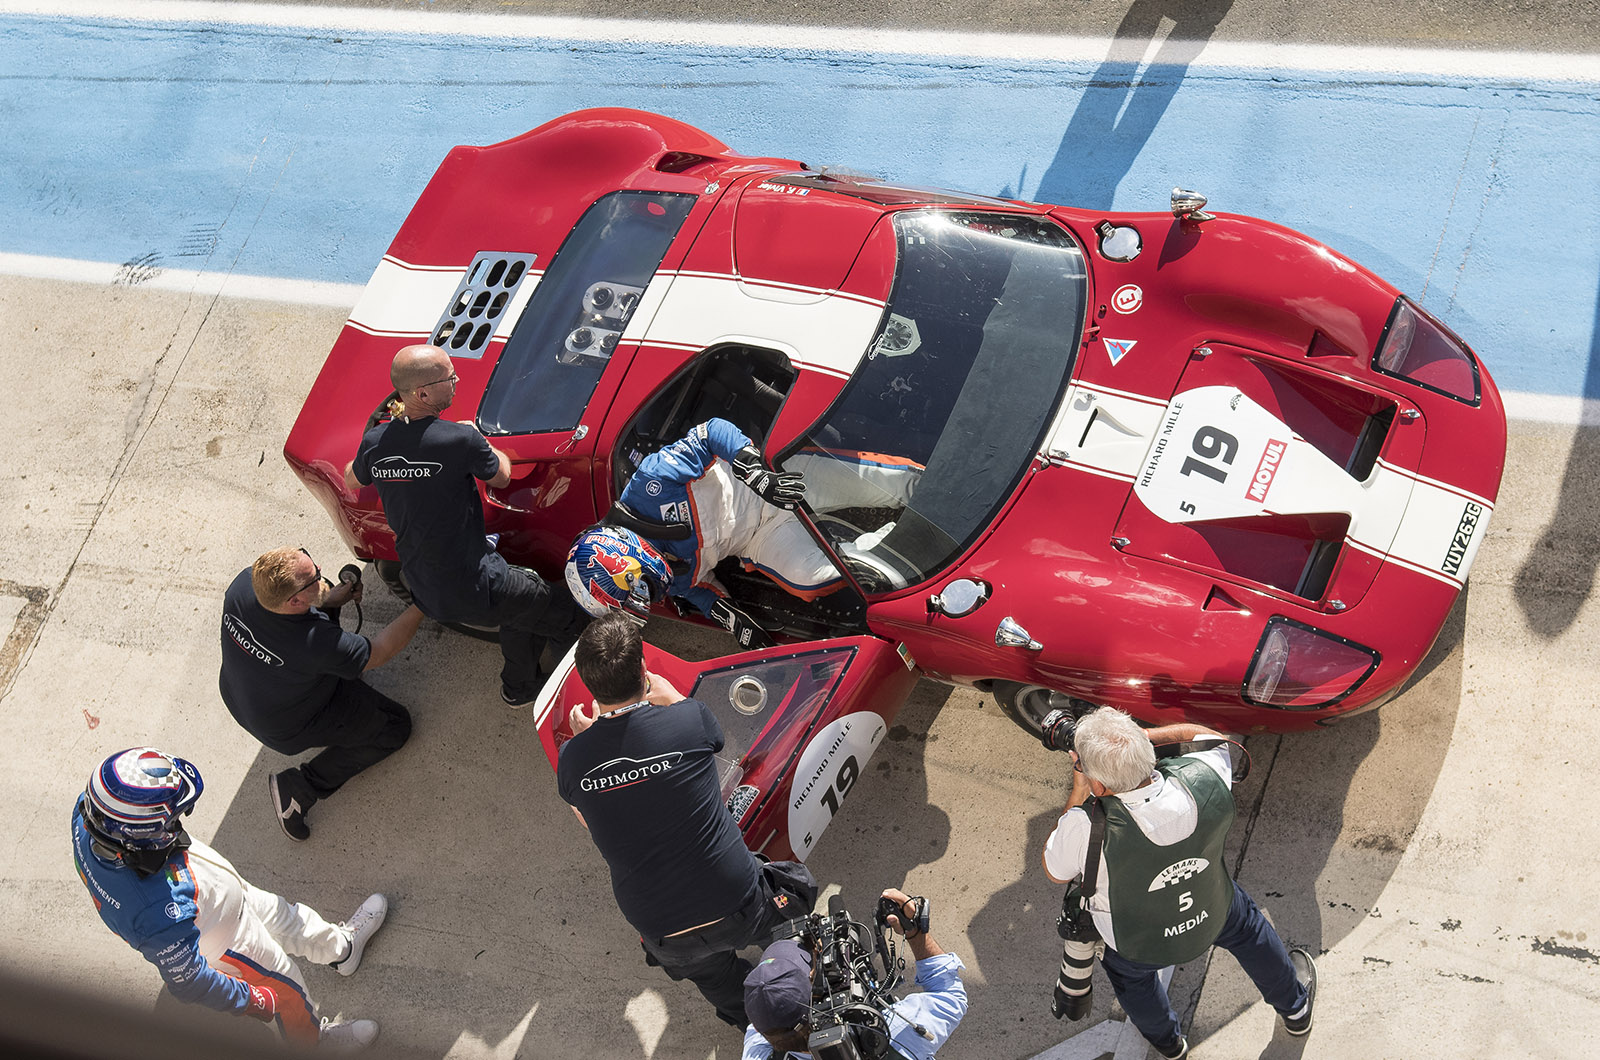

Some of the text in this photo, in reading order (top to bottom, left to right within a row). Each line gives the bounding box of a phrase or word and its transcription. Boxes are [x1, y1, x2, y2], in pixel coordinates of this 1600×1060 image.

[1120, 293, 1136, 306] E
[1140, 401, 1184, 488] RICHARD MILLE
[1179, 425, 1239, 484] 19
[371, 465, 432, 479] GIPIMOTOR
[1249, 442, 1285, 501] MOTUL
[1179, 500, 1197, 516] 5
[584, 534, 630, 555] Red Bull
[1441, 502, 1482, 574] YUY263G
[223, 613, 272, 665] GIPIMOTOR
[740, 627, 752, 646] OMP
[580, 760, 672, 792] GIPIMOTOR
[793, 721, 853, 810] RICHARD MILLE
[820, 754, 860, 818] 19
[803, 831, 813, 849] 5
[1178, 890, 1194, 913] 5
[1164, 909, 1209, 938] MEDIA
